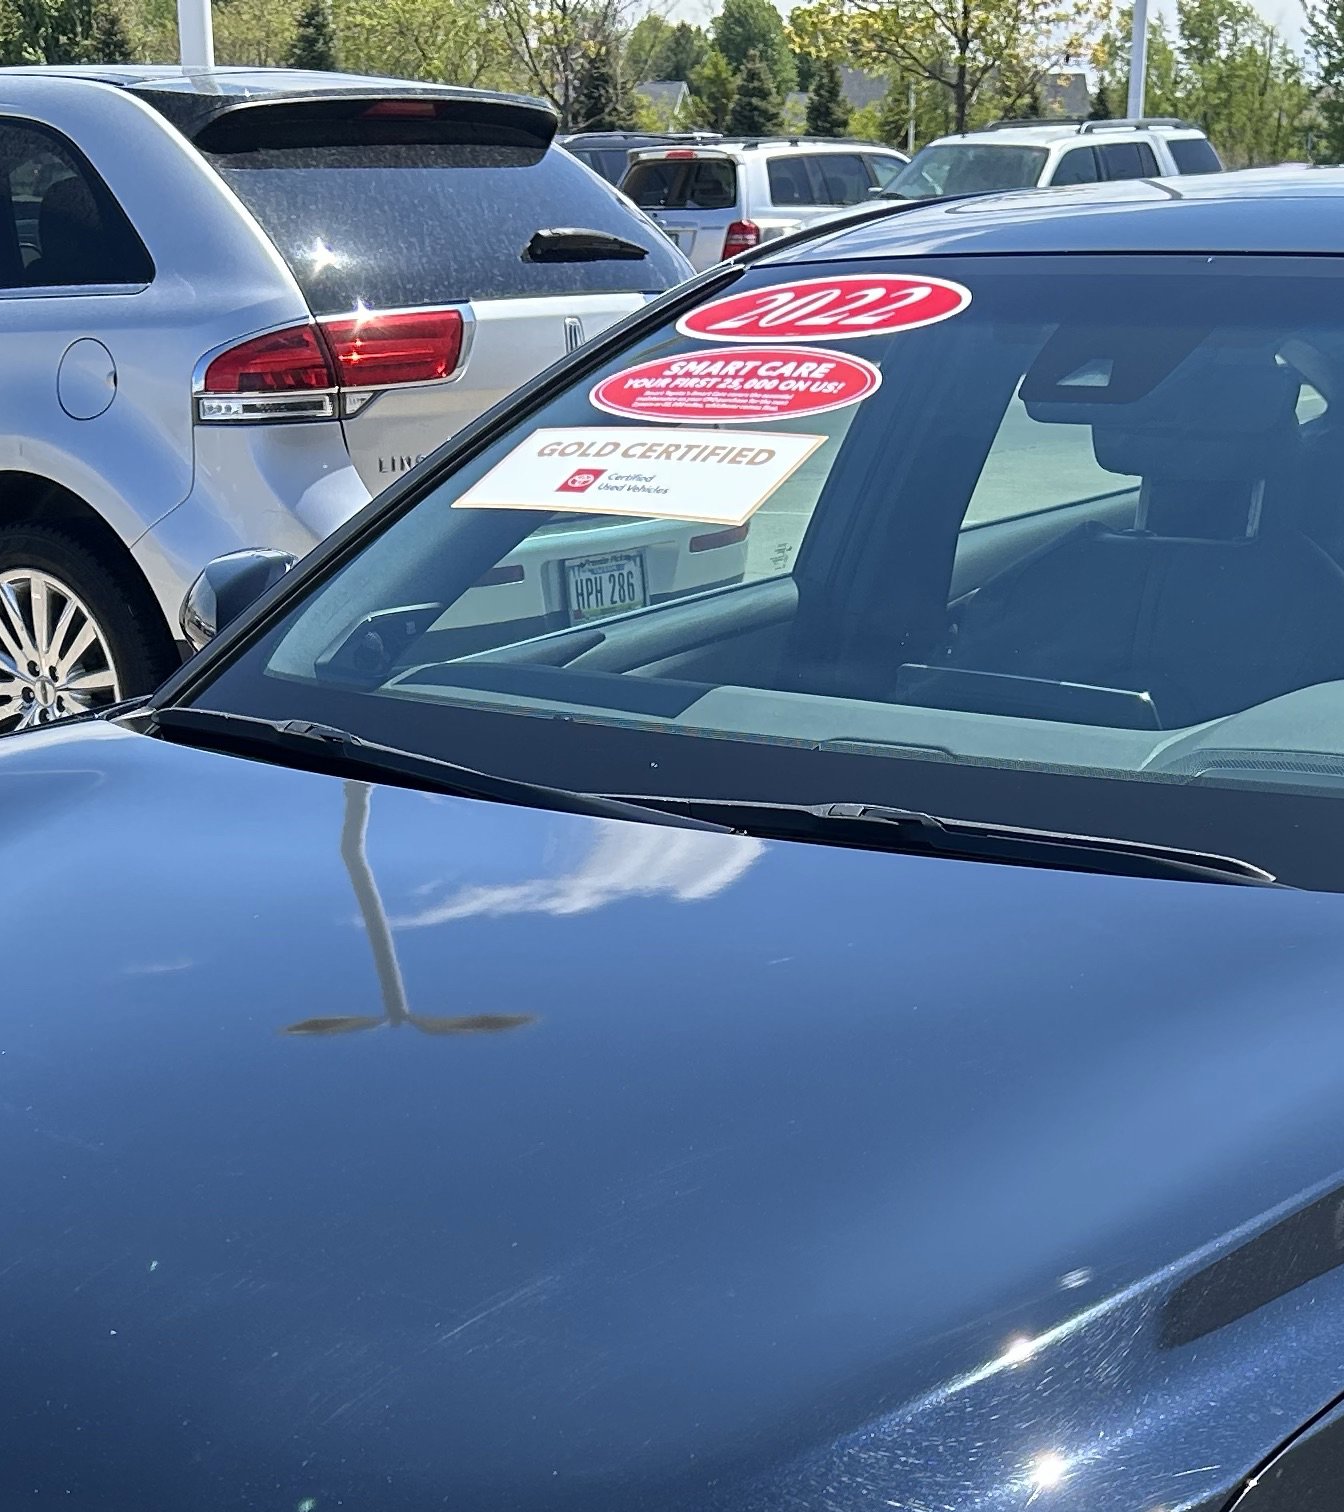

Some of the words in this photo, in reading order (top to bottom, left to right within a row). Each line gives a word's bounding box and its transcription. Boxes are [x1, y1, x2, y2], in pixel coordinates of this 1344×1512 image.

[706, 286, 933, 331] 2022
[663, 360, 763, 376] SMART
[757, 361, 836, 379] CARE
[624, 378, 672, 389] YOUR
[669, 377, 724, 389] FIRST
[716, 377, 778, 391] 25,000
[777, 379, 813, 392] ON
[809, 381, 846, 394] US!
[537, 441, 621, 458] GOLD
[621, 442, 777, 466] CERTIFIED
[607, 473, 656, 483] Certified
[597, 482, 625, 492] Used
[626, 483, 670, 495] Vehicles
[575, 575, 604, 610] HPH
[608, 570, 636, 605] 286
